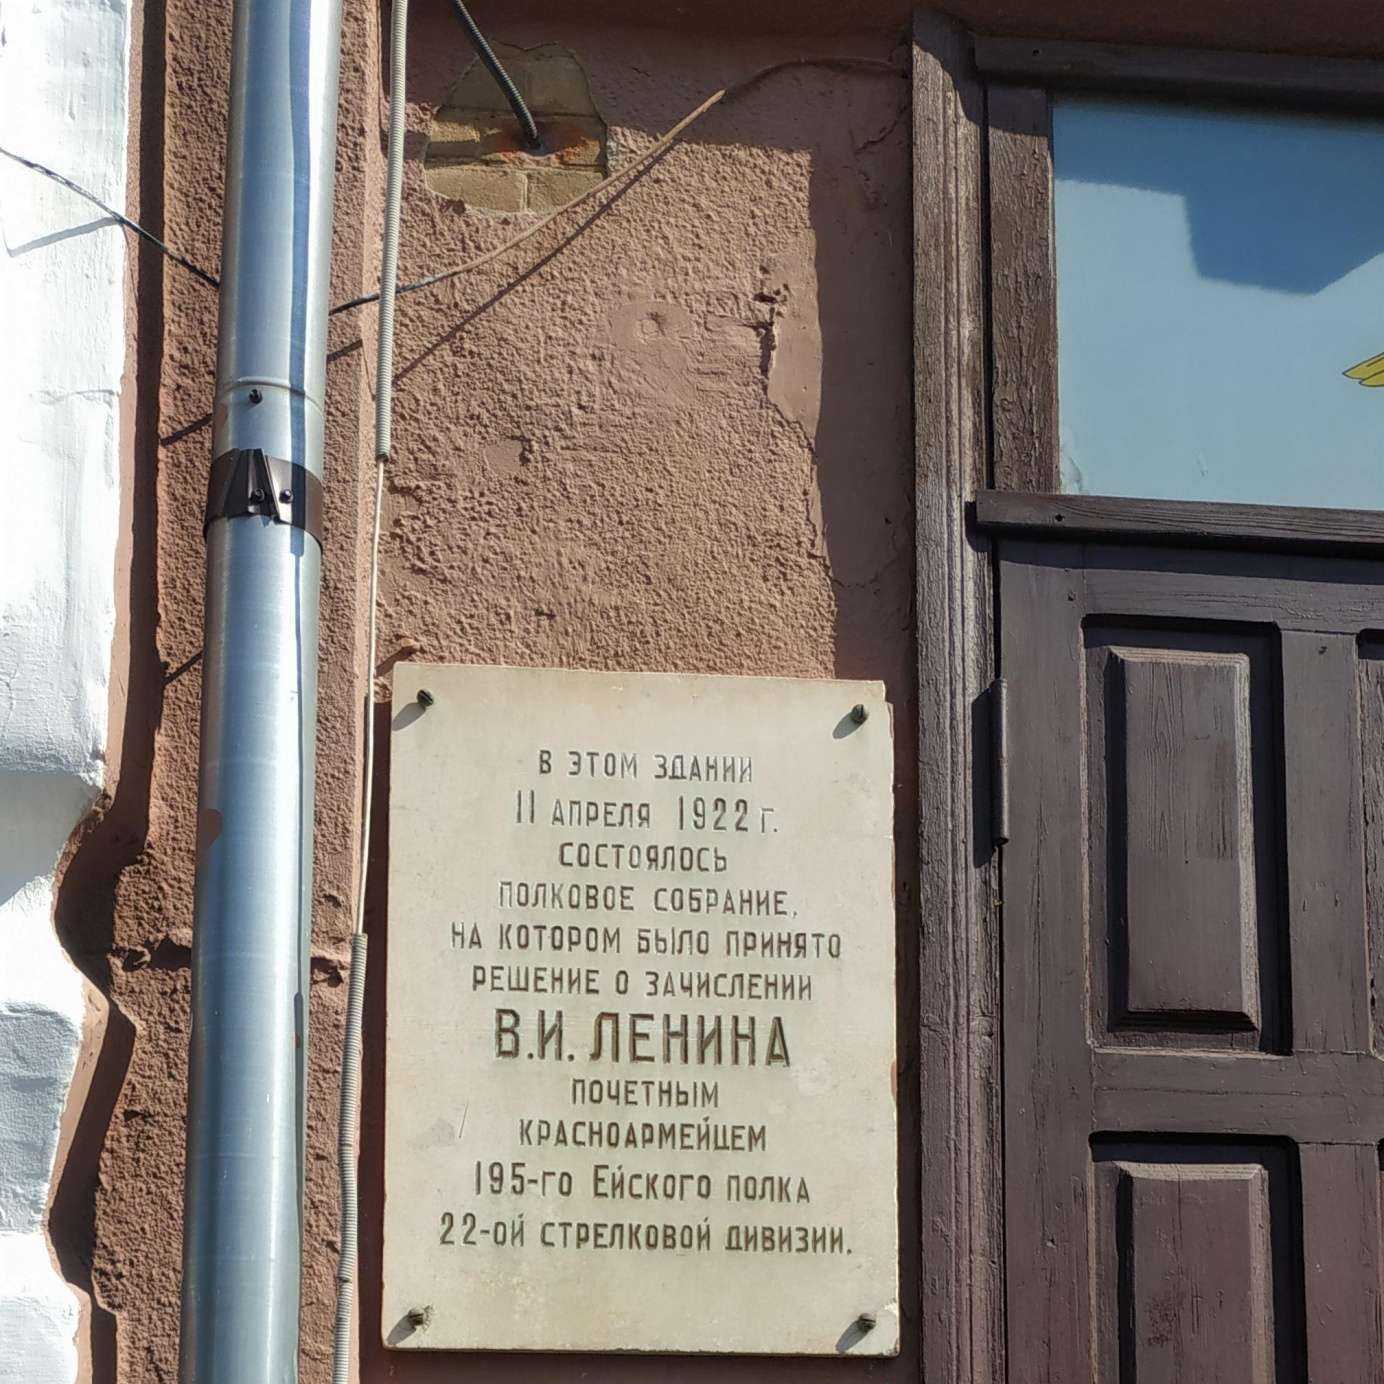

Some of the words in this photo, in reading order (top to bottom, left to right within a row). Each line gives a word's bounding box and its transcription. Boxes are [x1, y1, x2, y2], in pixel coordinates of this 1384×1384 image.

[539, 750, 552, 775] В
[568, 751, 637, 778] ЭТОМ
[654, 754, 752, 782] ЗДАНИИ
[516, 790, 535, 824] 11
[551, 798, 651, 829] АПРЕЛЯ
[678, 795, 749, 832] 1922
[558, 842, 729, 872] СОСТОЯЛОСЬ
[498, 881, 635, 911] ПОЛКОВОЕ
[653, 887, 799, 918] СОБРАНИЕ,
[450, 922, 483, 951] НА
[499, 923, 621, 954] КОТОРОМ
[637, 927, 710, 956] БЫЛО
[725, 929, 841, 959] ПРИНЯТО
[472, 965, 600, 995] РЕШЕНИЕ
[615, 968, 629, 994] О
[645, 970, 813, 1001] ЗАЧИСЛЕНИИ
[494, 1007, 576, 1062] В.И.
[587, 1011, 791, 1067] ЛЕНИНА
[572, 1077, 719, 1108] ПОЧЕТНЫМ
[519, 1115, 767, 1151] КРАСНОАРМЕЙЦЕМ
[539, 1217, 711, 1251] СТРЕЛКОВОЙ
[724, 1225, 853, 1255] ДИВИЗИИ.
